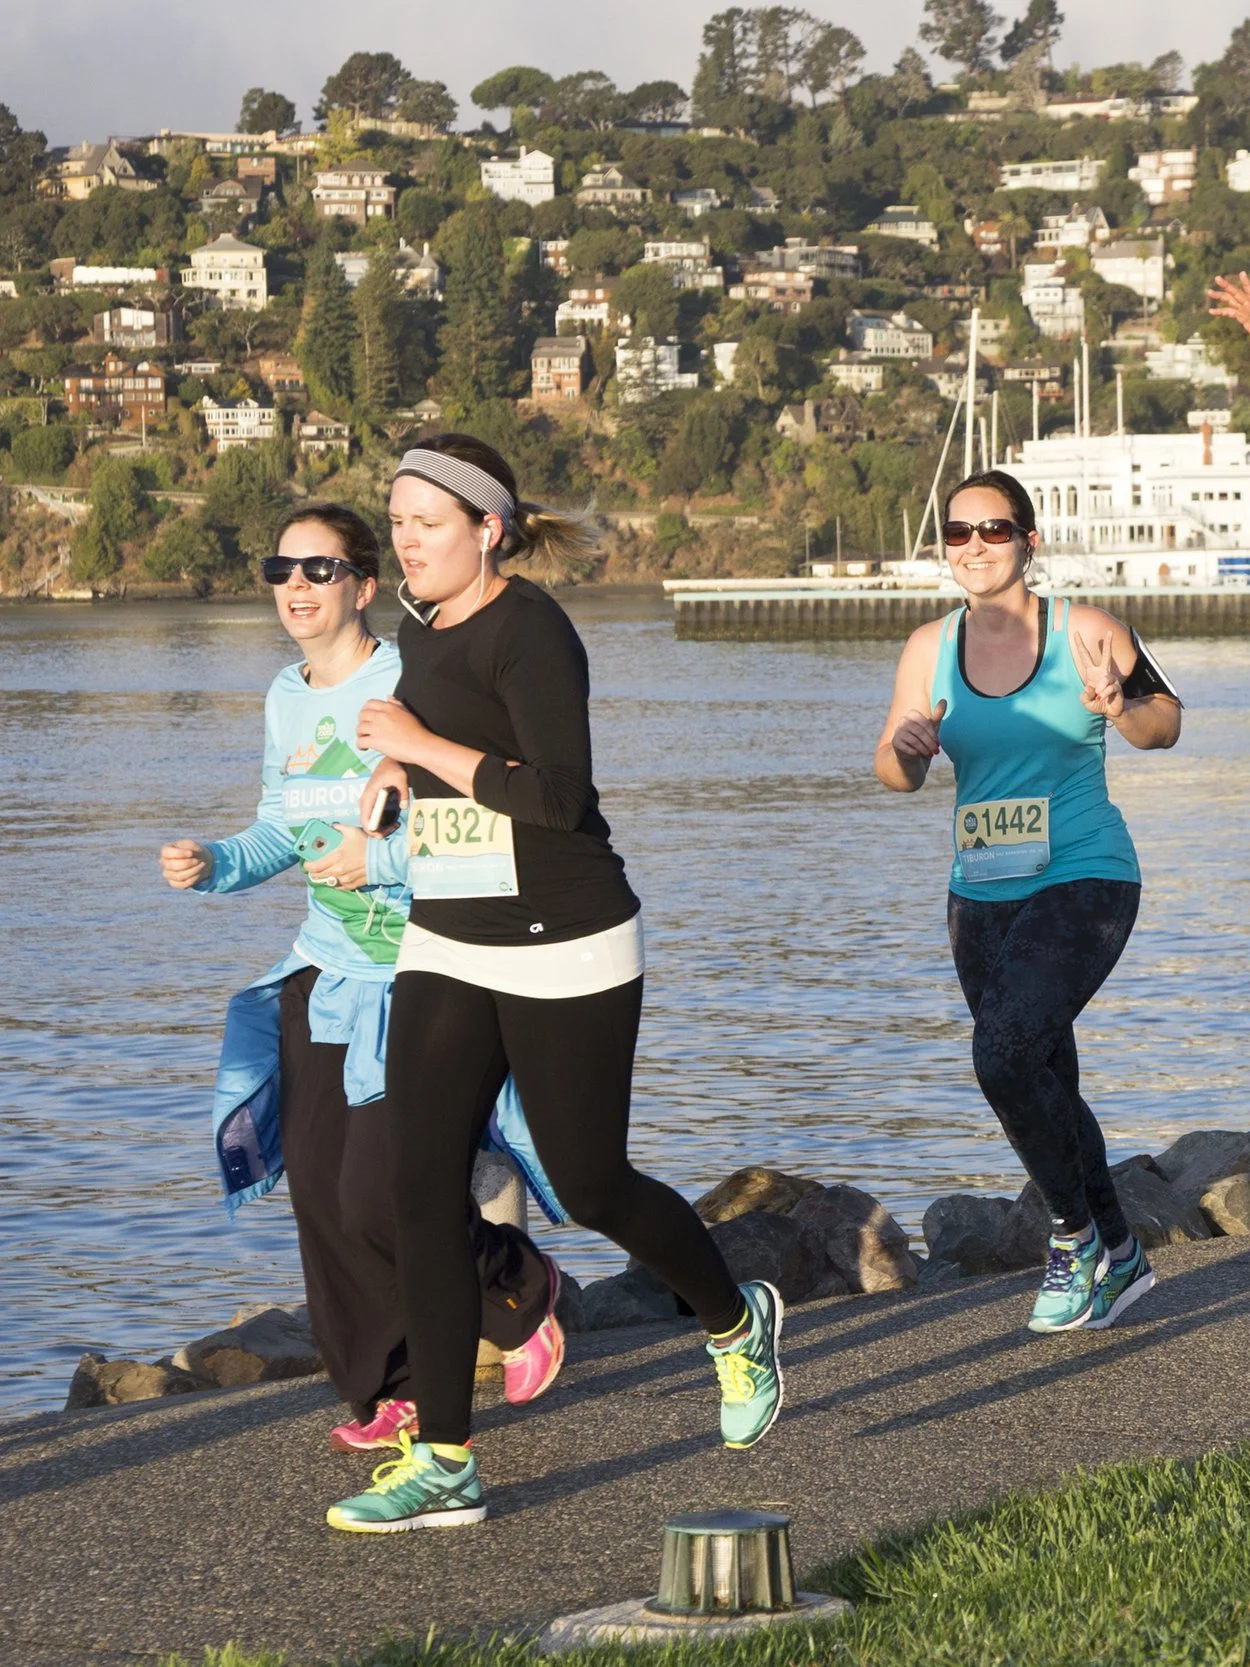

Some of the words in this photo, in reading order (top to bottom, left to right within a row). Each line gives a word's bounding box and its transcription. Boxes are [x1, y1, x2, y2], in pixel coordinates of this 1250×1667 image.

[430, 807, 500, 844] 1327
[981, 804, 1042, 837] 1442
[963, 850, 996, 863] TIBURON
